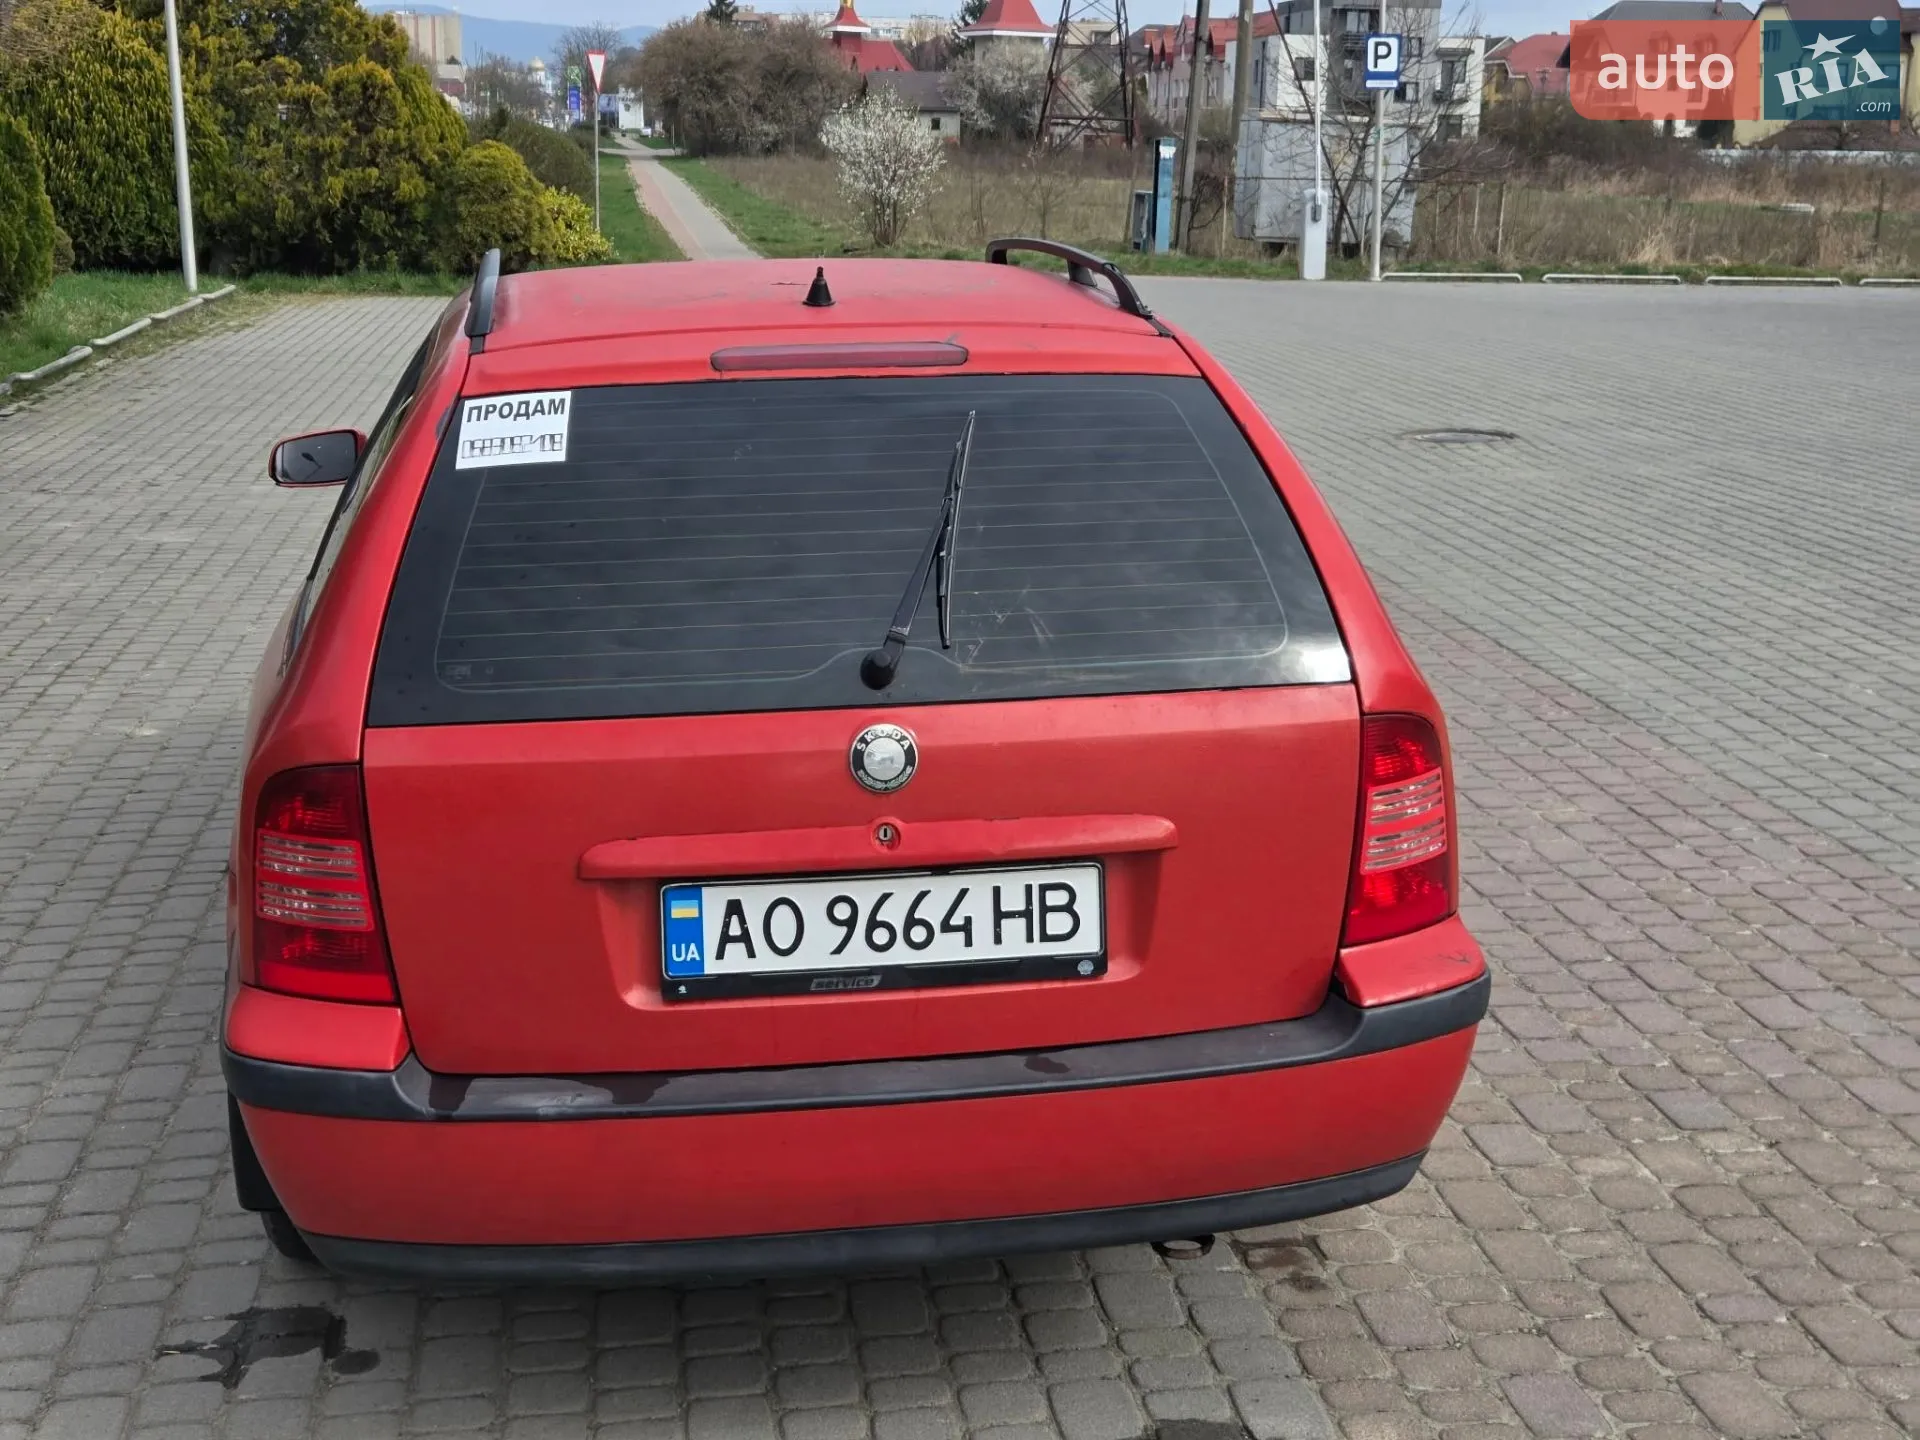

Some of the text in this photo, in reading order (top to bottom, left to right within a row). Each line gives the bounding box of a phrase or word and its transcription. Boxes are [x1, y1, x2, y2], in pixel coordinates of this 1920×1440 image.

[1373, 41, 1392, 69] P
[466, 398, 566, 422] ПРОДАМ
[715, 881, 1081, 960] AO 9664 HB
[671, 943, 700, 962] UA
